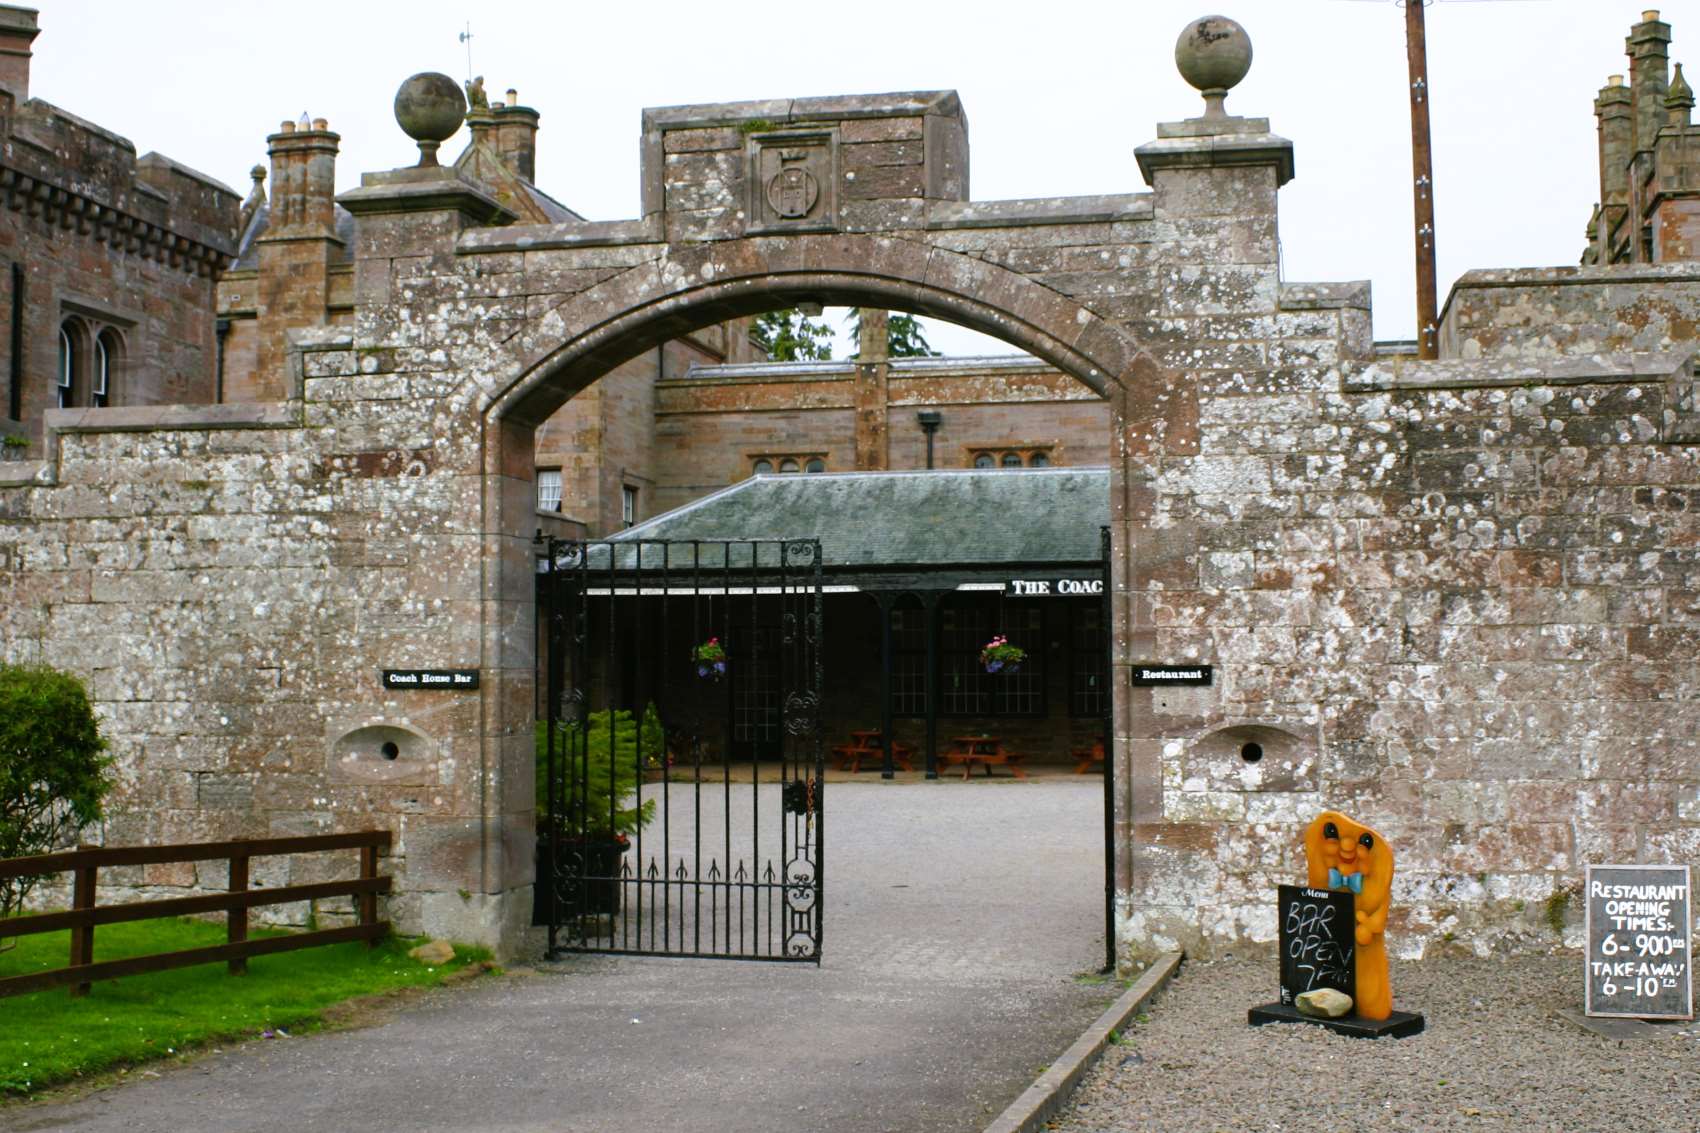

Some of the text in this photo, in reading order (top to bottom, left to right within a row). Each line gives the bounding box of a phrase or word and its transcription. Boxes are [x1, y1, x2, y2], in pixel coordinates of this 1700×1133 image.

[1012, 580, 1050, 595] THE
[389, 673, 472, 683] Coach House Bar
[1142, 669, 1203, 679] Restaurant
[1301, 888, 1329, 899] Menu
[1591, 881, 1687, 900] RESTAURANT
[1605, 901, 1672, 917] OPENING
[1286, 902, 1337, 939] BAR
[1289, 934, 1353, 967] OPEN
